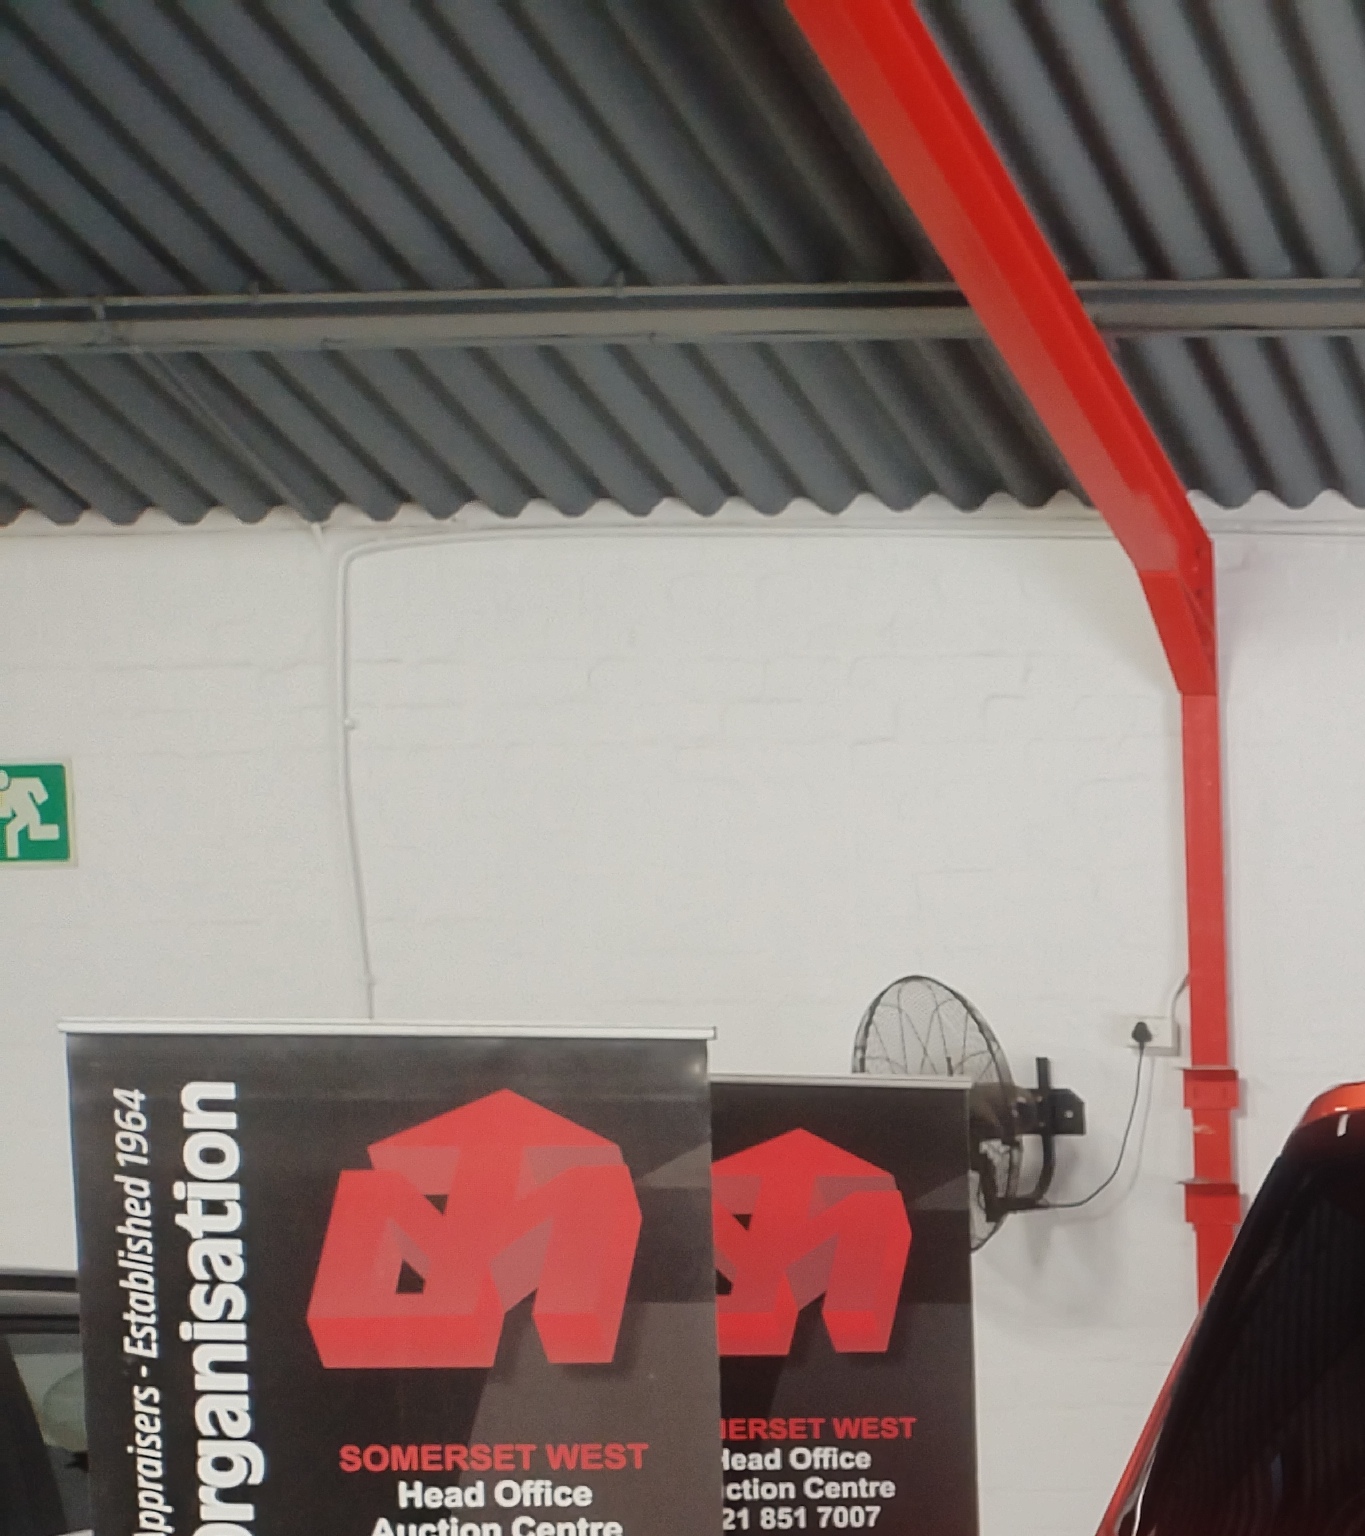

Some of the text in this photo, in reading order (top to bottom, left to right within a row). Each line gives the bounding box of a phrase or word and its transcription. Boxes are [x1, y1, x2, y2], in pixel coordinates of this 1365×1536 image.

[112, 1087, 149, 1167] 1964
[113, 1173, 159, 1359] Established
[720, 1417, 917, 1440] ERSET WEST
[339, 1442, 649, 1472] SOMERSET WEST
[789, 1446, 872, 1470] Office
[398, 1479, 593, 1509] Head Office
[724, 1476, 896, 1500] ction Centre
[760, 1505, 881, 1530] 851 7007
